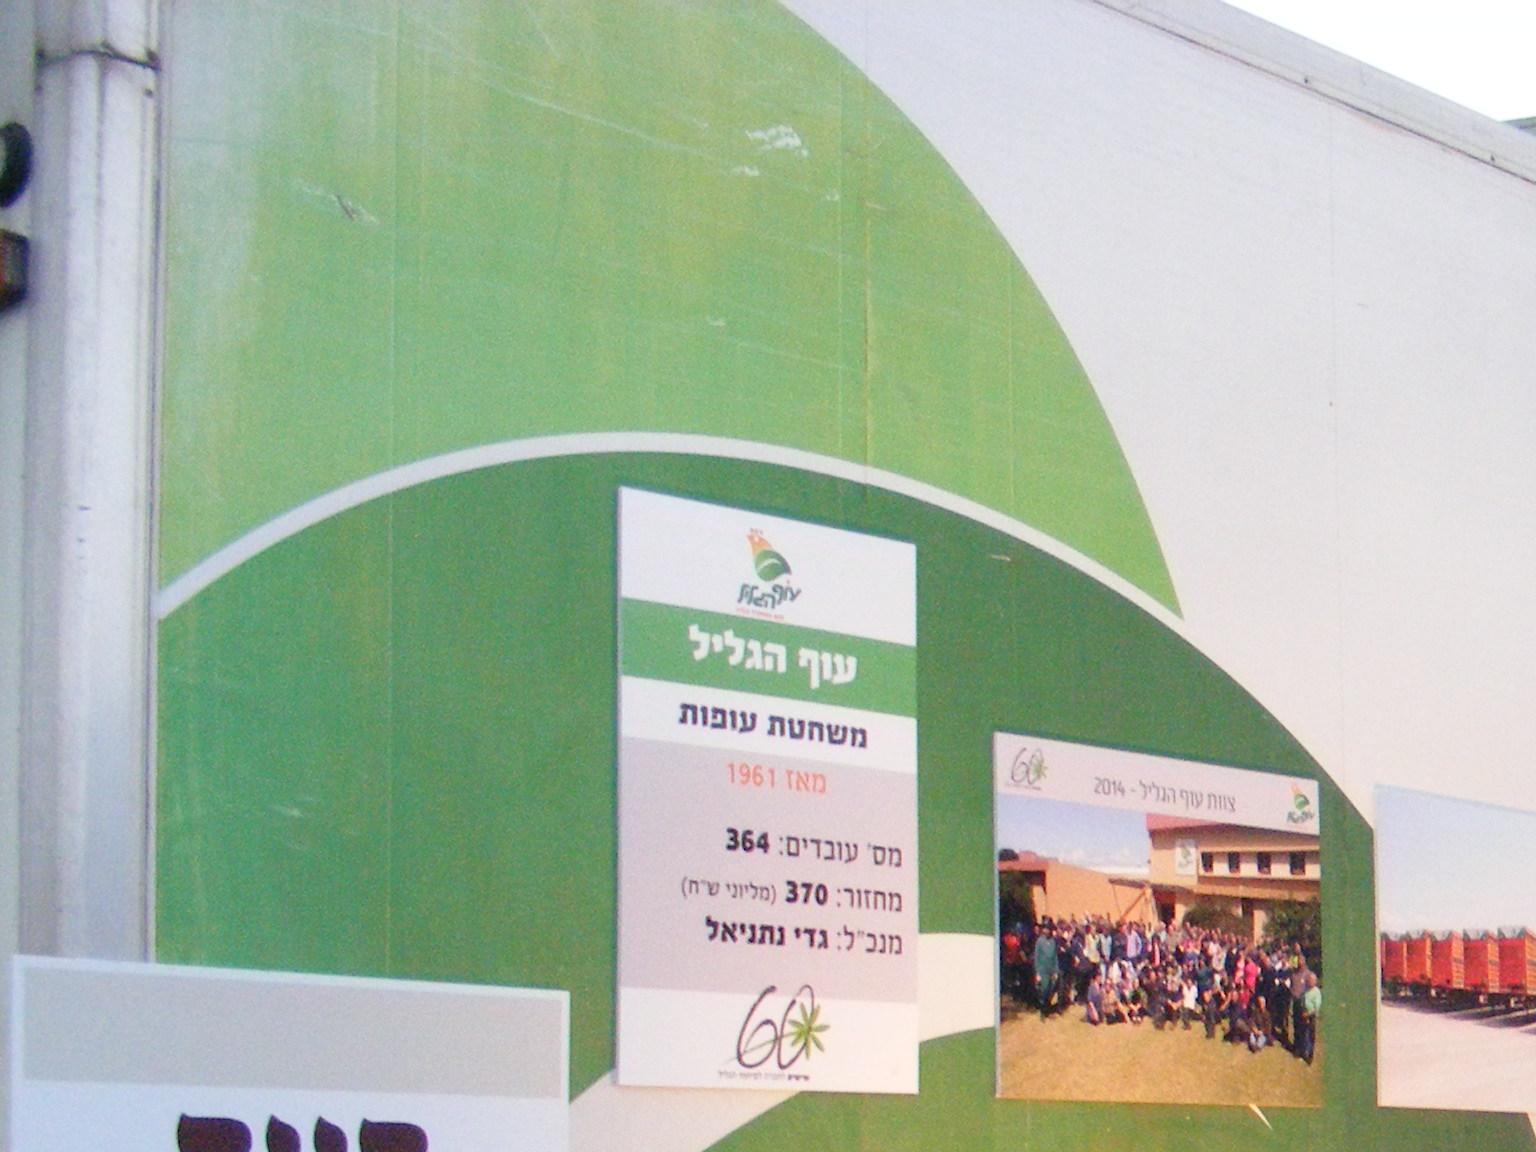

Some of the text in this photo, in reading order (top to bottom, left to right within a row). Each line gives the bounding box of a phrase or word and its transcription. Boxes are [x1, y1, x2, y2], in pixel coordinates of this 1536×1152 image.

[687, 623, 858, 690] עוף הגליל
[678, 702, 869, 749] משחטת עופות
[727, 763, 828, 794] מאז 1961
[1093, 775, 1126, 797] 2014
[1179, 788, 1205, 811] עוף
[1207, 793, 1237, 813] צוות
[725, 827, 770, 854] 364
[778, 834, 859, 864] עובדים:
[785, 880, 829, 906] 370
[837, 887, 903, 913] מחזור:
[705, 915, 786, 947] נתניאל
[794, 926, 829, 950] גדי
[736, 983, 816, 1071] 60
